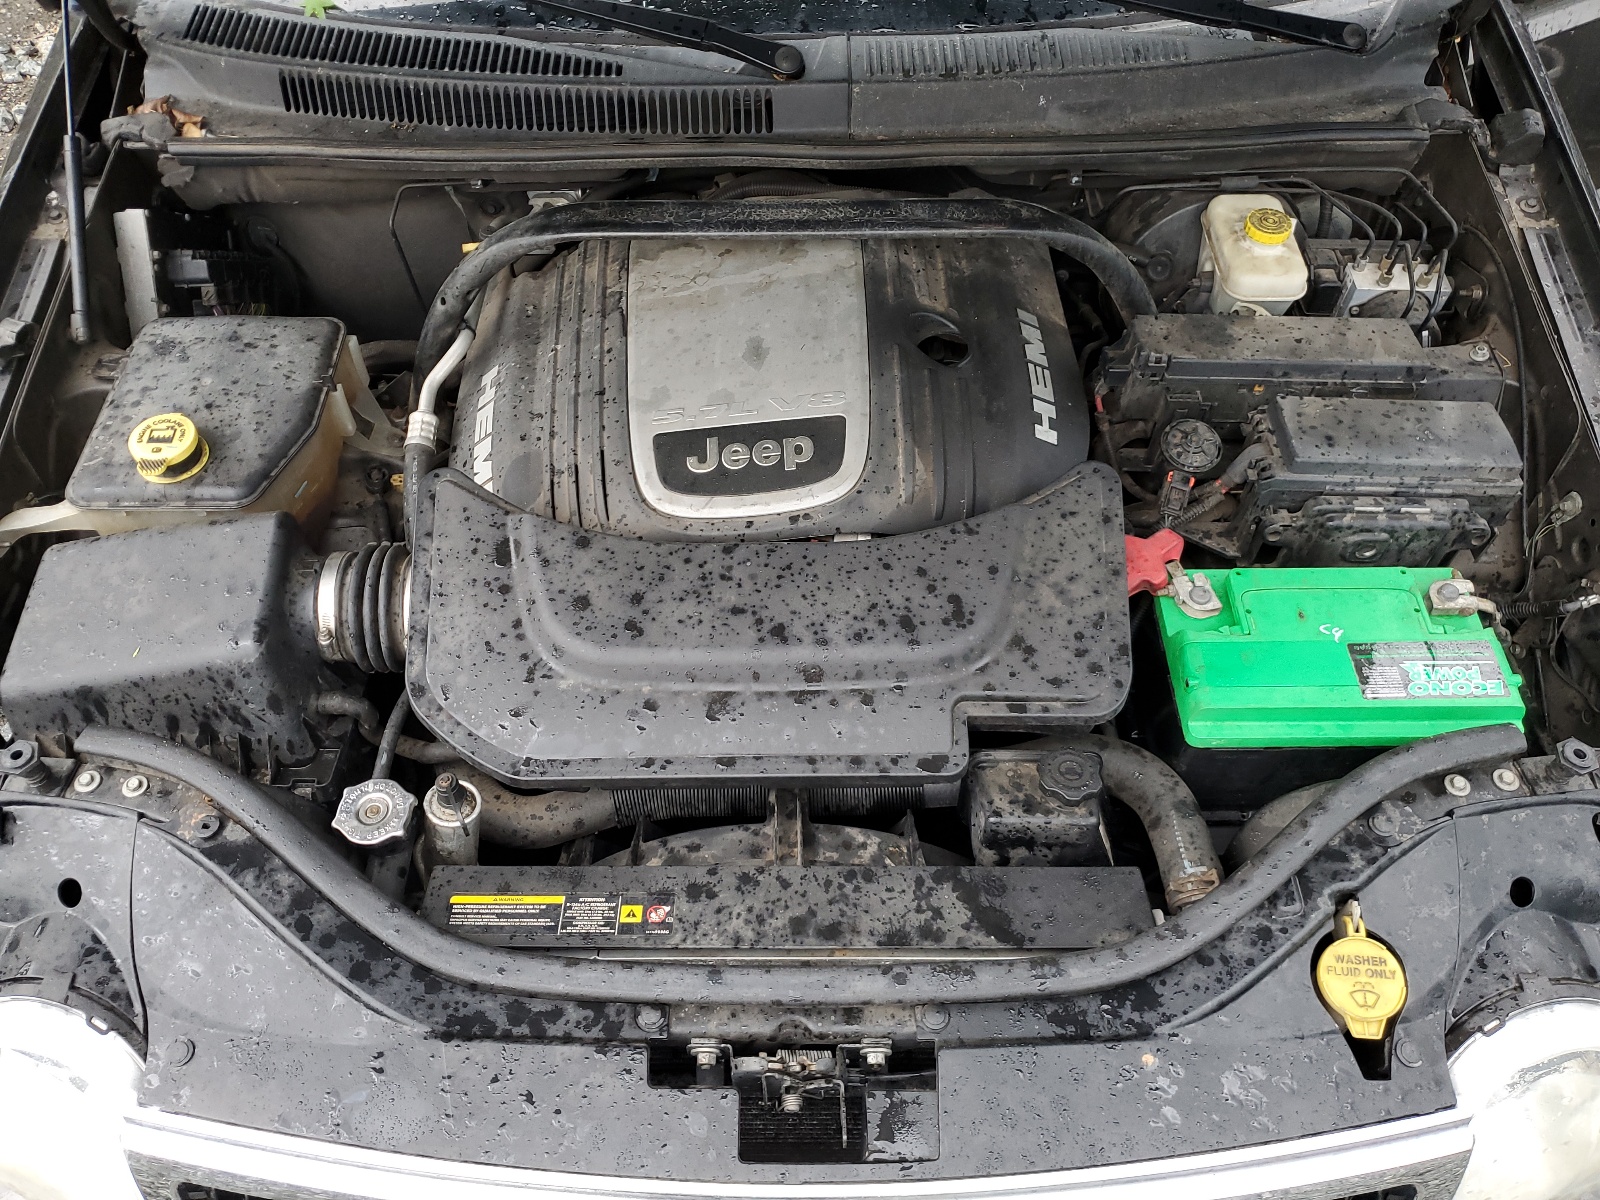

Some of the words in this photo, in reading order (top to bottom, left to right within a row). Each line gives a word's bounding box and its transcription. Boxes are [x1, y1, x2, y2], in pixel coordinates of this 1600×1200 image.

[1016, 307, 1058, 445] HEMI
[651, 402, 758, 425] 5.7L
[768, 391, 847, 412] V8
[686, 436, 815, 473] Jeep
[1404, 663, 1482, 682] POWER
[1408, 680, 1505, 696] ECONO
[1333, 954, 1388, 967] WASHER
[1326, 965, 1361, 978] FLUID
[1364, 968, 1397, 980] ONLY
